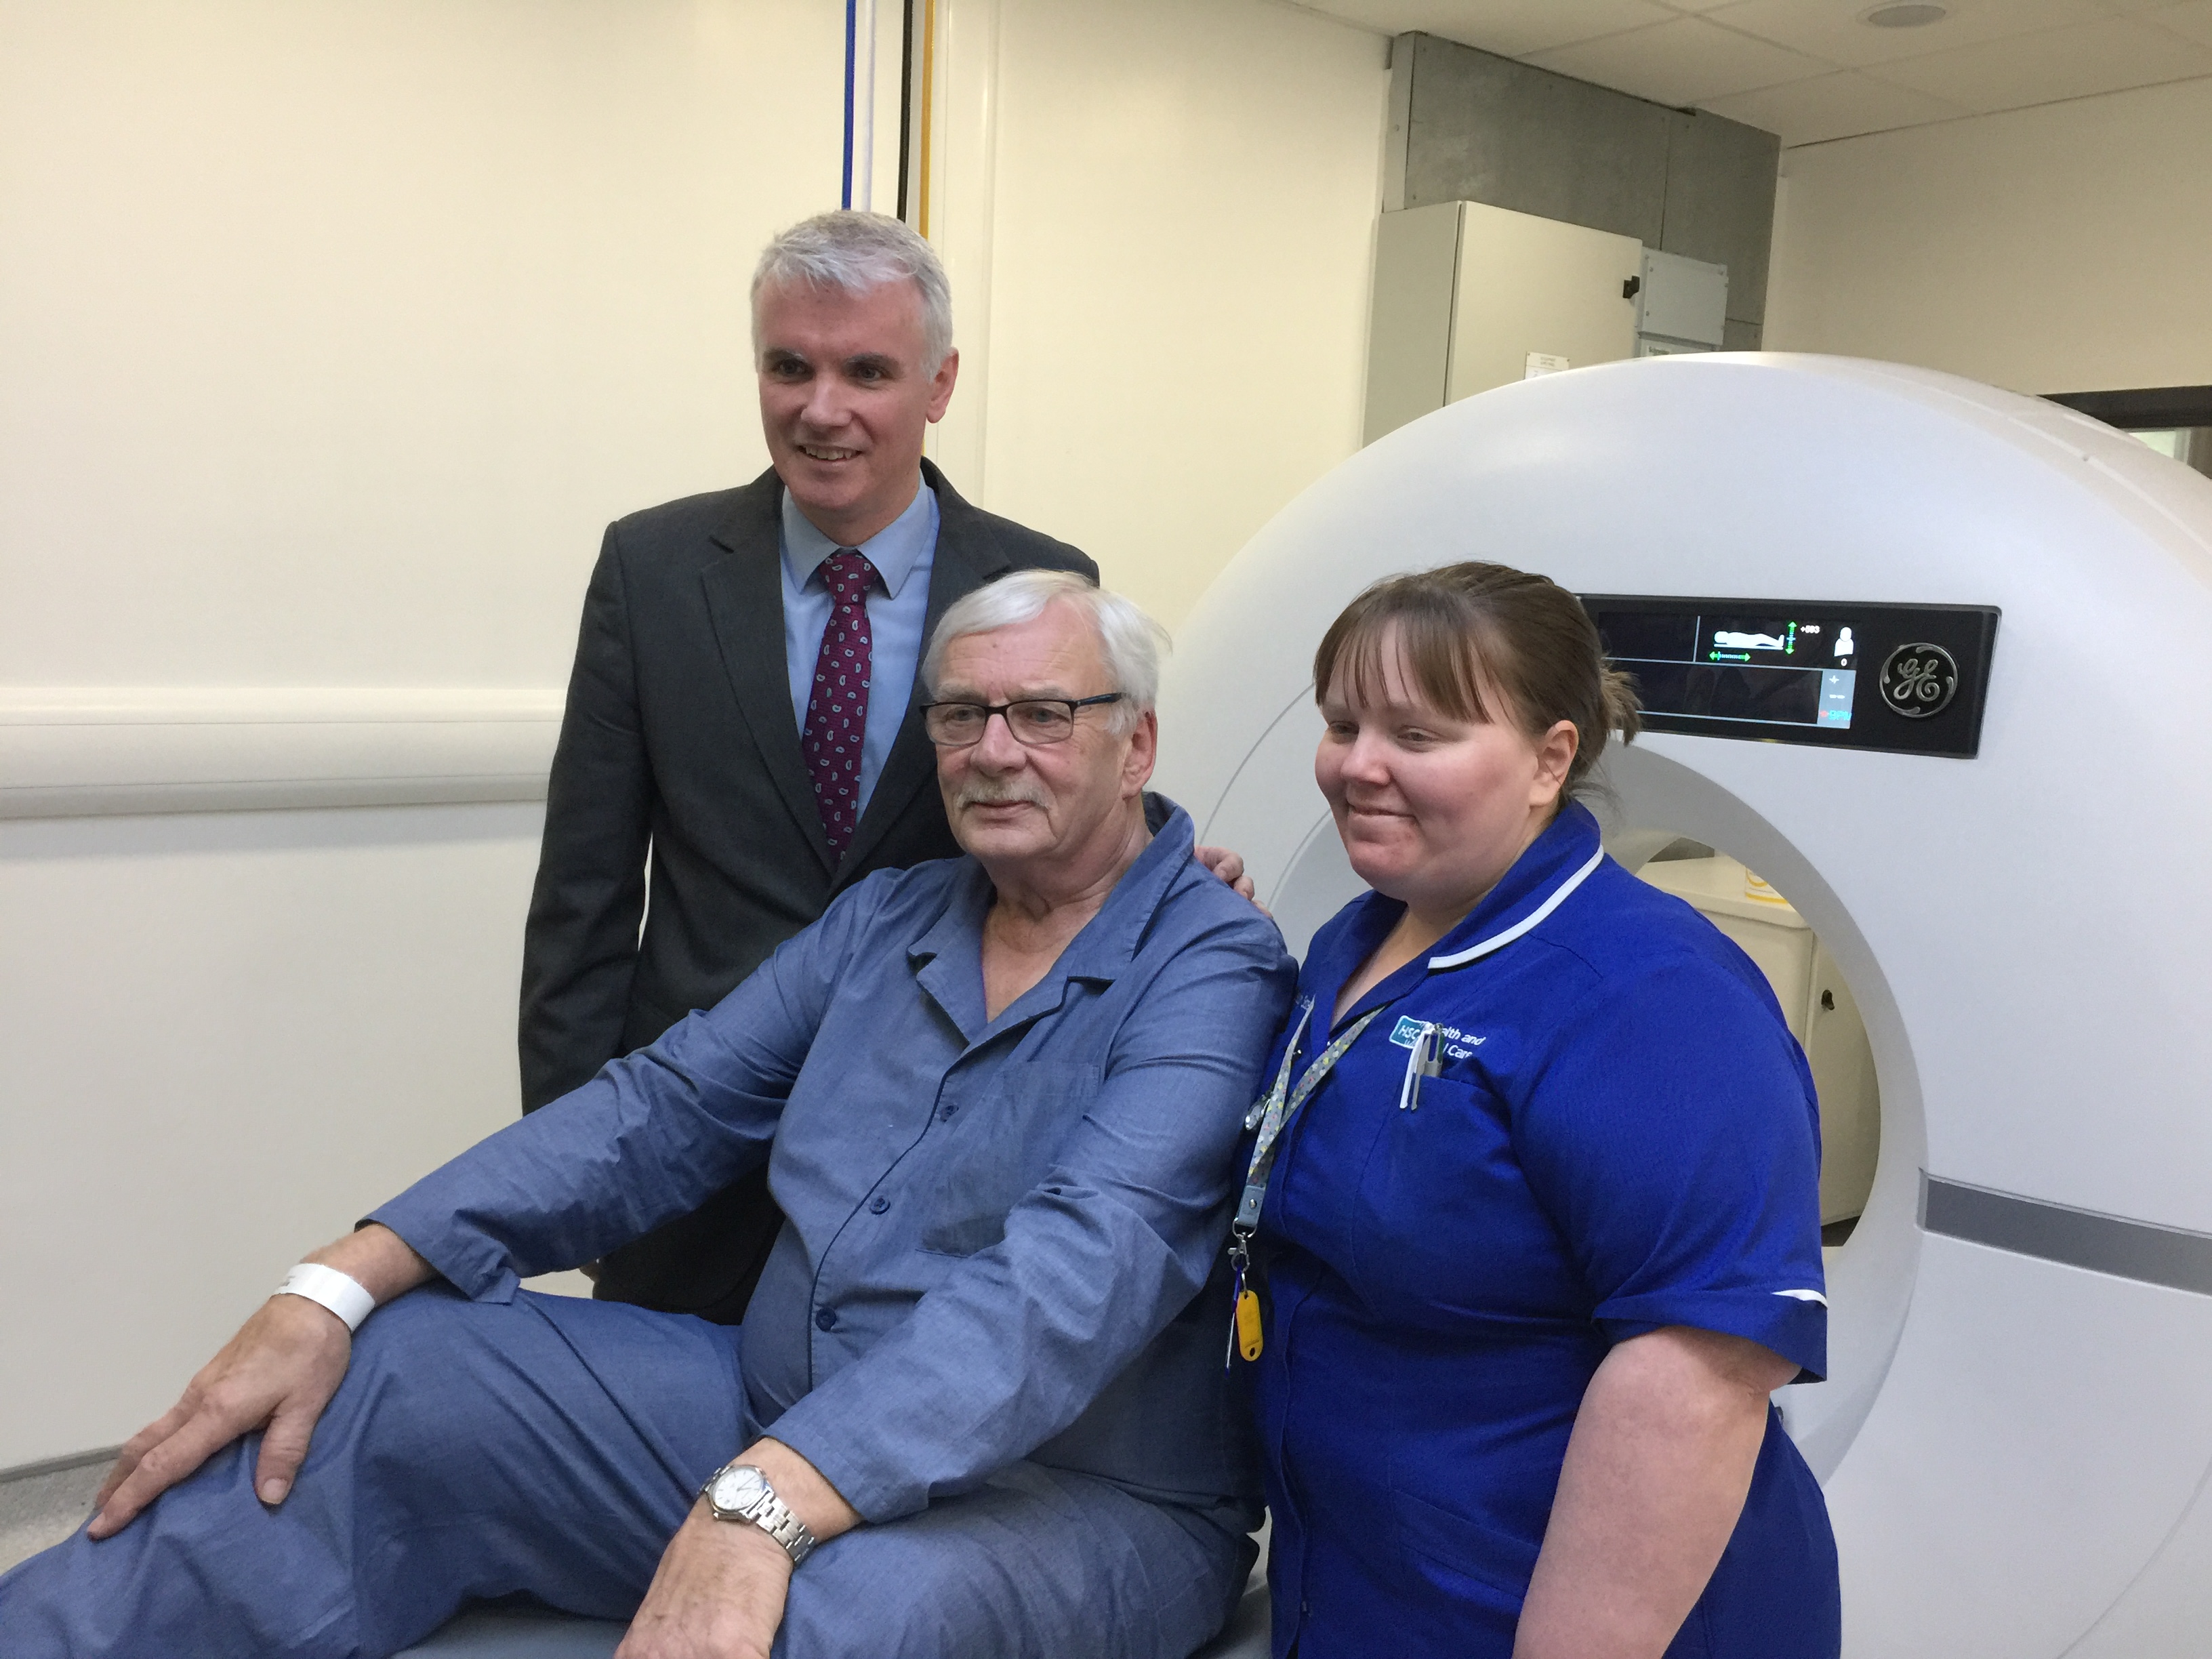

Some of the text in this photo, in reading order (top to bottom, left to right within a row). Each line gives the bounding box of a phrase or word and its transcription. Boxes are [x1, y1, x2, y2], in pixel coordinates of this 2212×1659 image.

[1398, 1025, 1420, 1040] HSC
[1442, 1027, 1487, 1046] alth and
